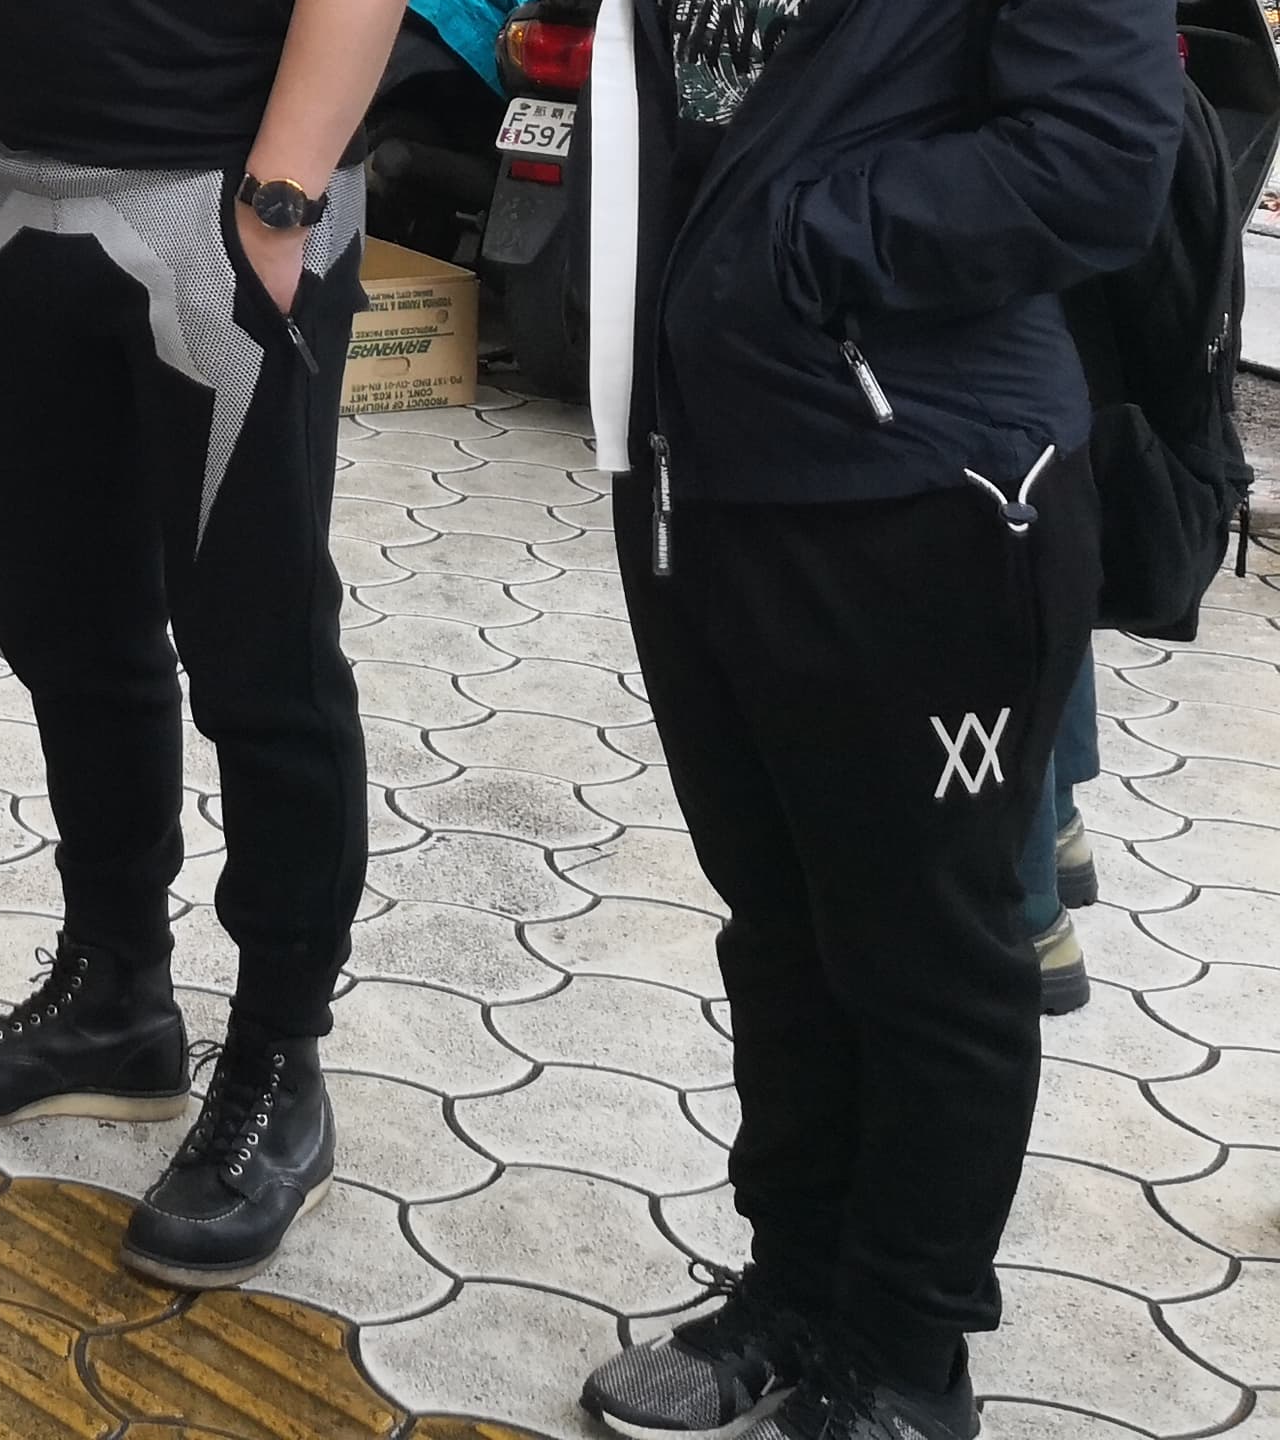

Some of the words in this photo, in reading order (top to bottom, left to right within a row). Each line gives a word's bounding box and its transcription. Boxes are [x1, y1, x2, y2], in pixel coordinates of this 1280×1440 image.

[509, 112, 527, 127] F
[520, 122, 573, 150] 597
[348, 339, 432, 359] BANANAS
[407, 396, 449, 409] PRODUCT
